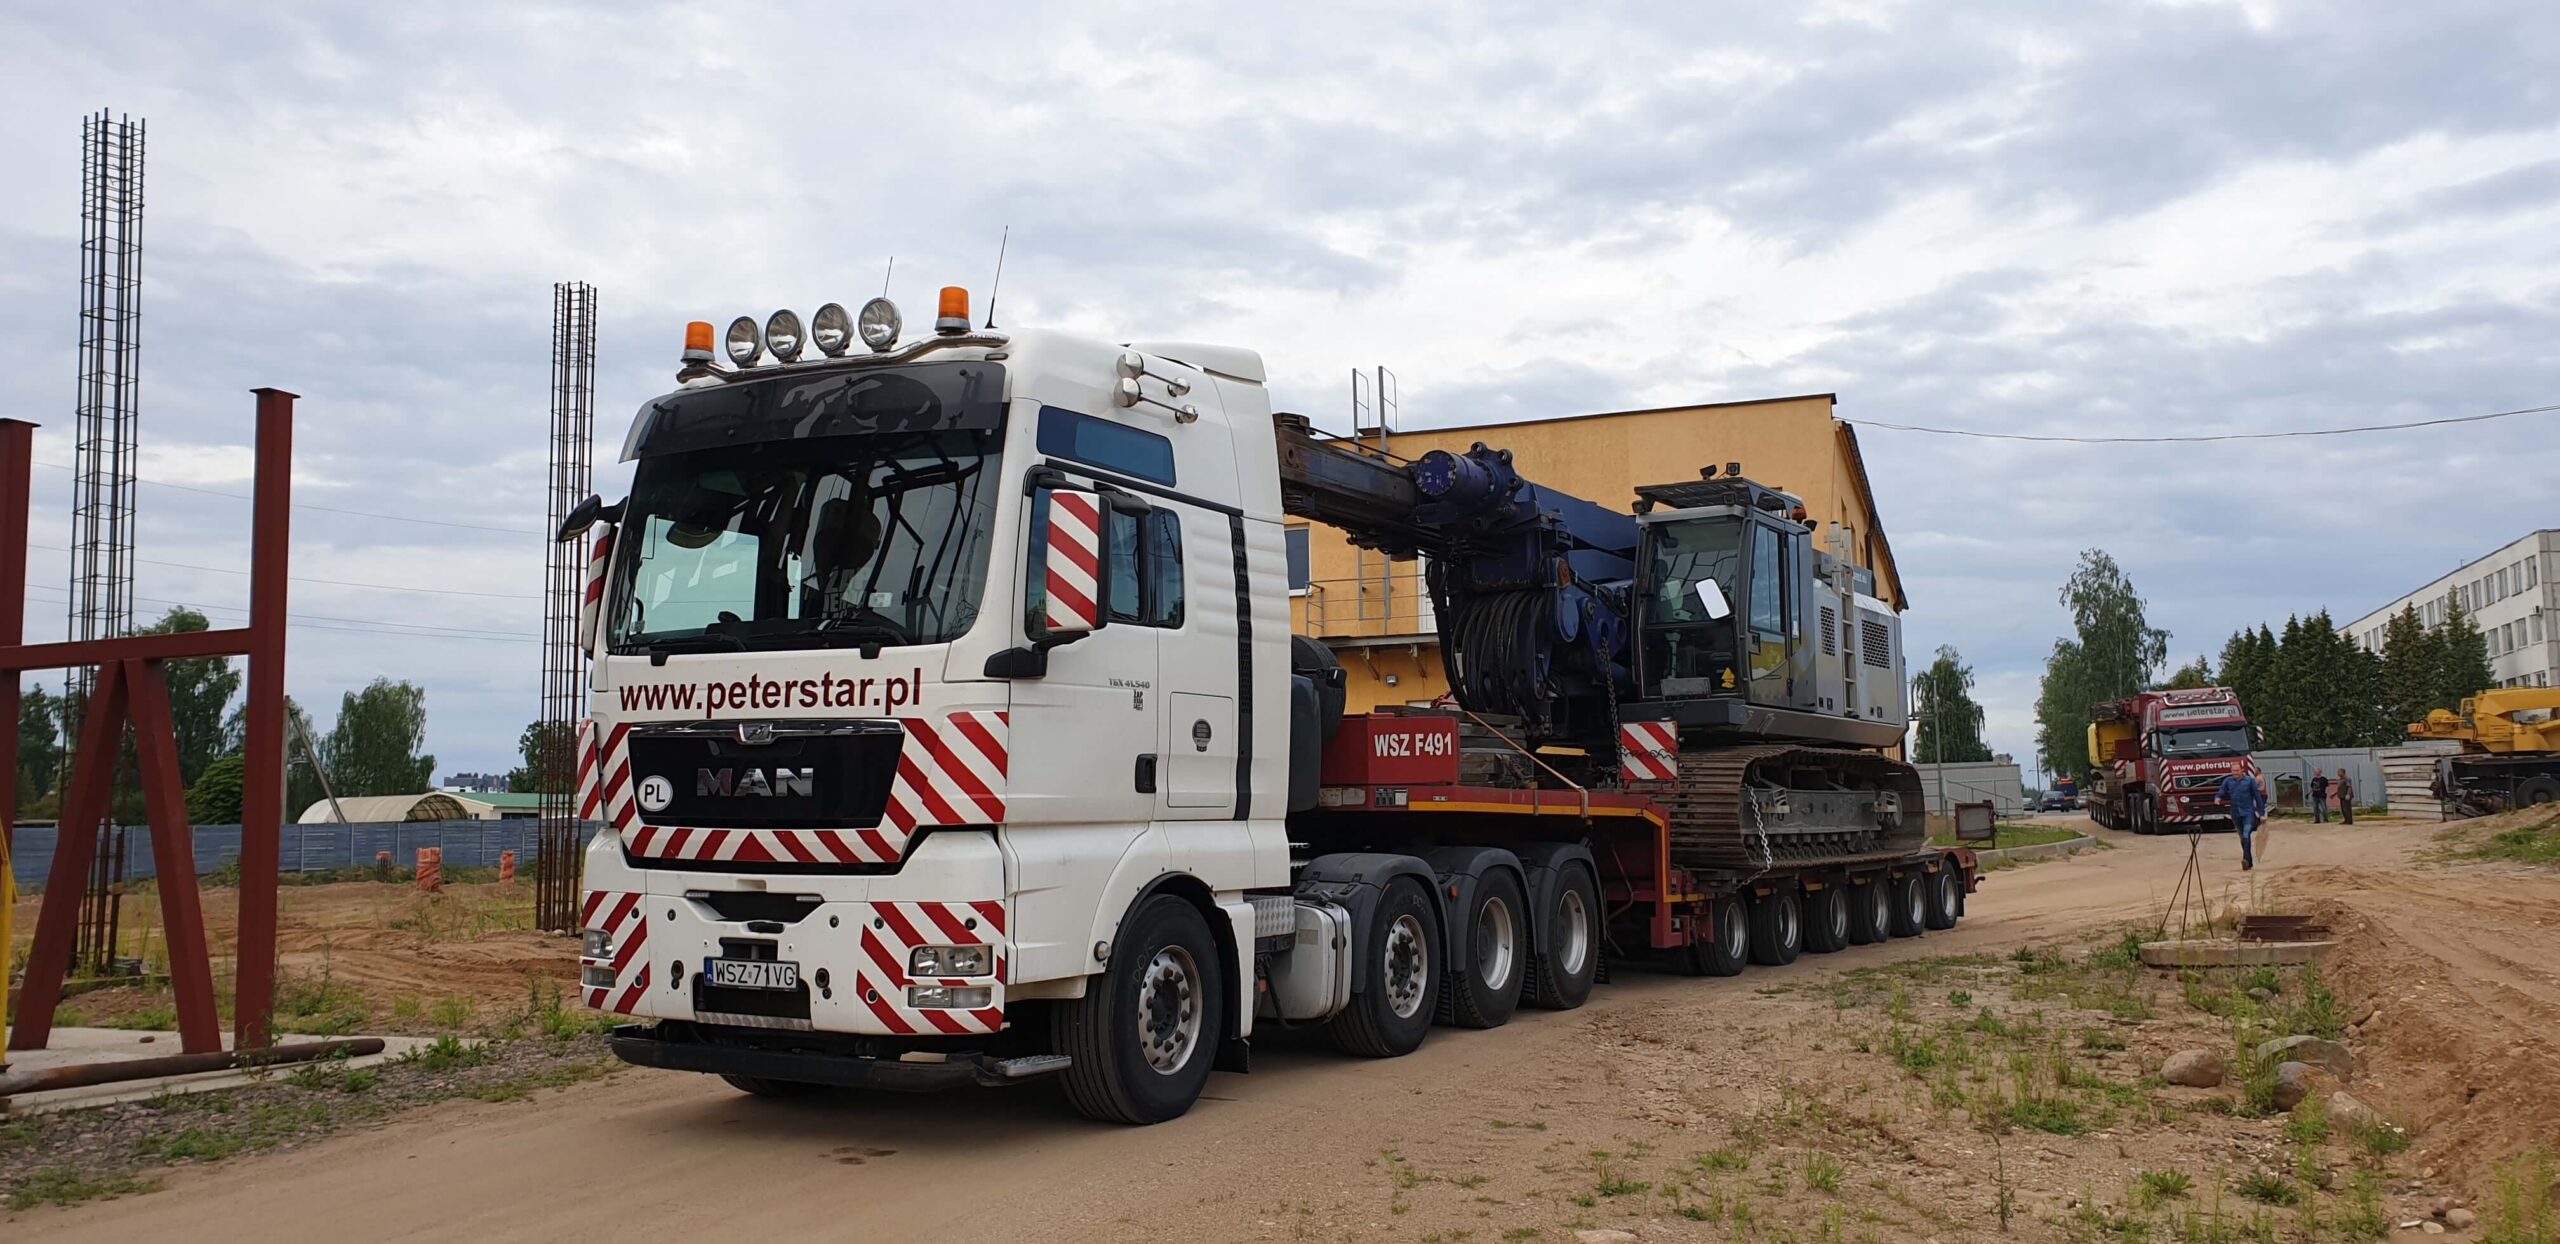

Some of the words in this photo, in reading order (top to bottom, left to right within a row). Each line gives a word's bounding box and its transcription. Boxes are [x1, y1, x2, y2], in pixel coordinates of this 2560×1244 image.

[619, 667, 921, 719] www.peterstar.pl
[1374, 733, 1411, 757] WSZ
[1415, 732, 1452, 756] F491
[643, 784, 666, 803] PL
[696, 767, 813, 797] MAN
[715, 962, 748, 984] WSZ
[752, 965, 796, 986] 71VG
